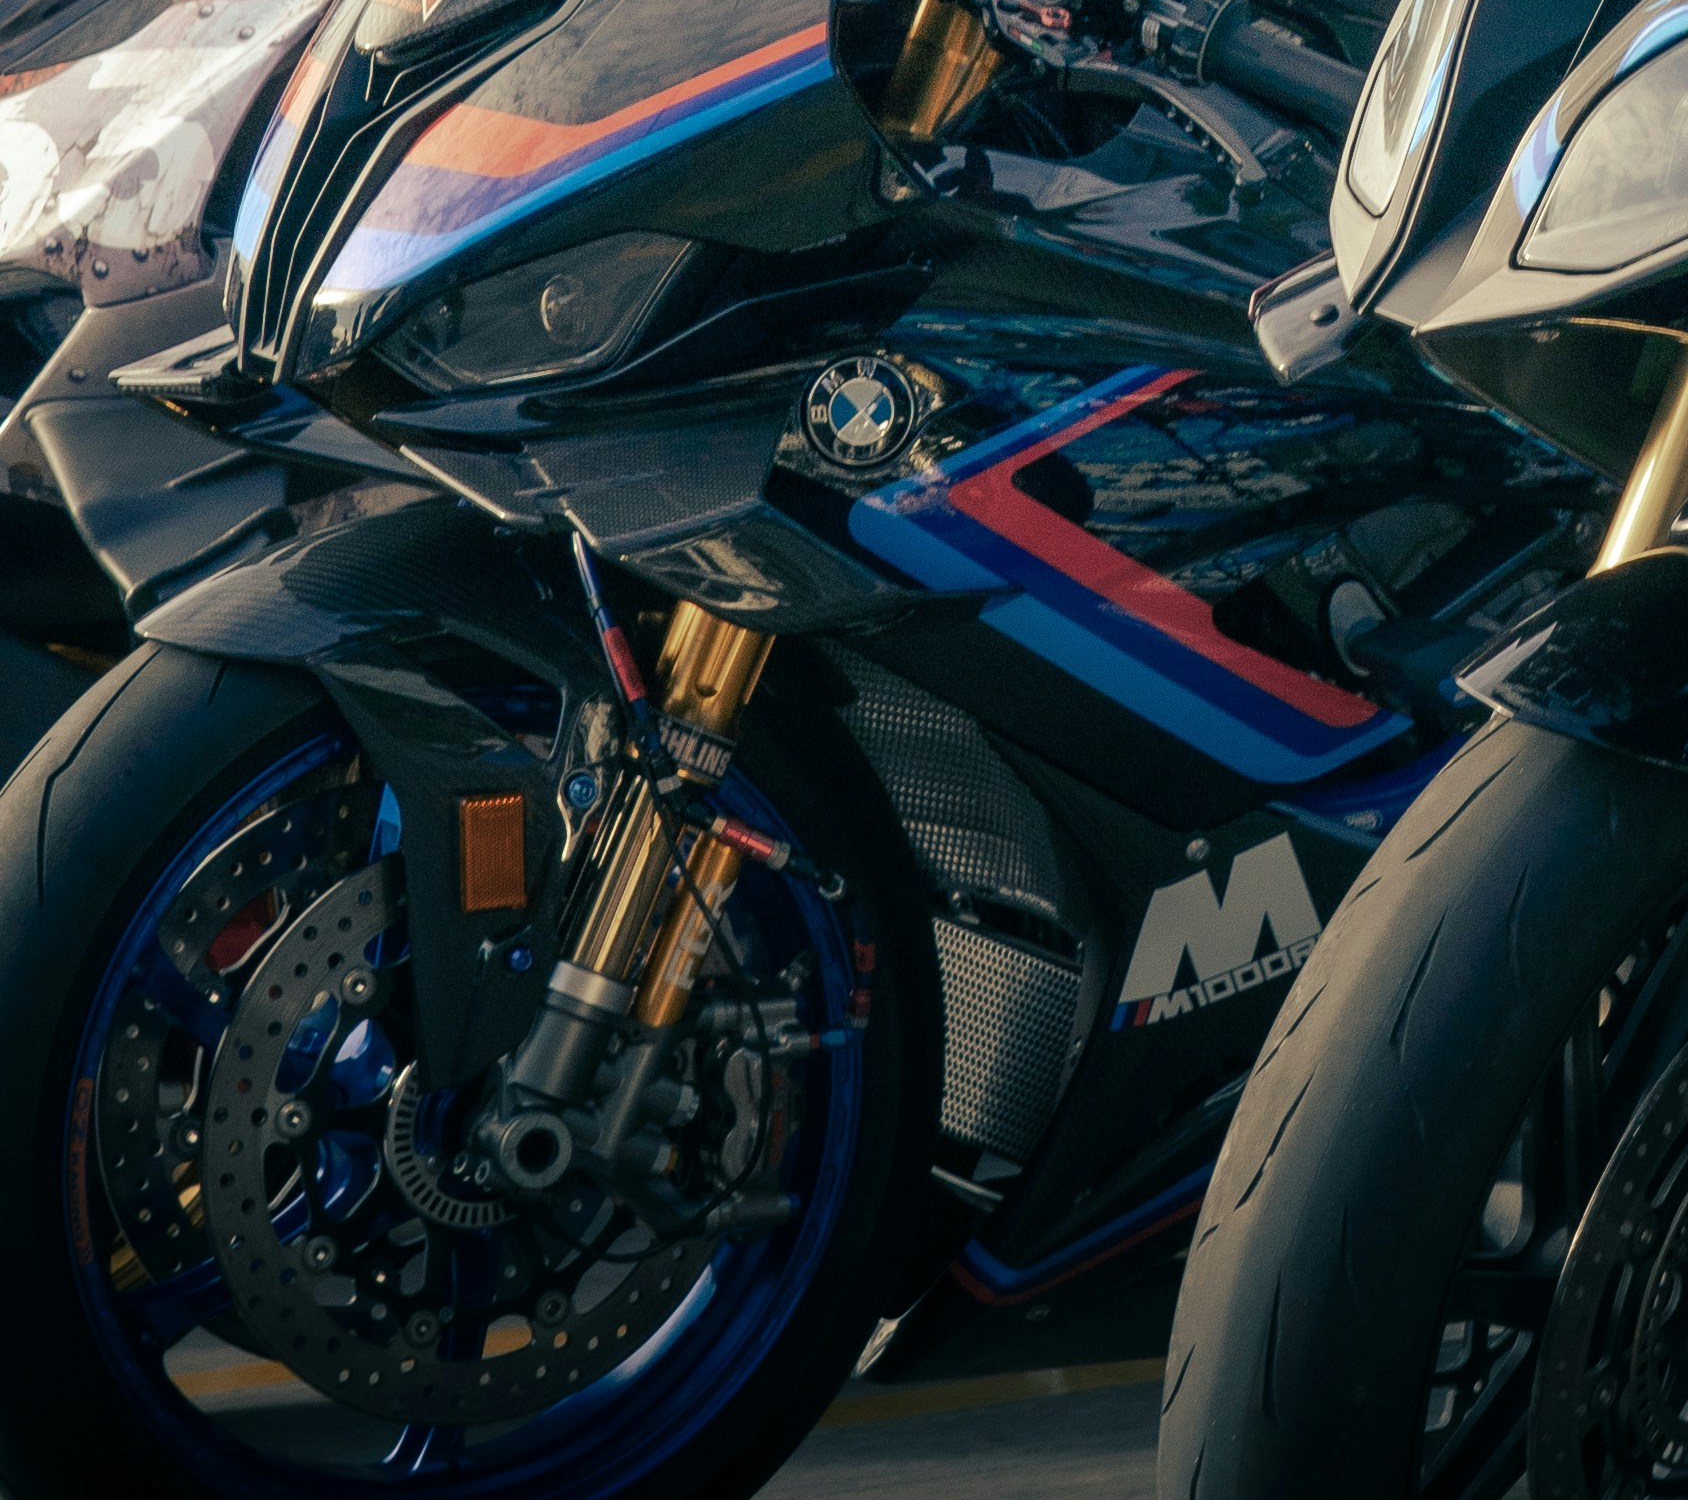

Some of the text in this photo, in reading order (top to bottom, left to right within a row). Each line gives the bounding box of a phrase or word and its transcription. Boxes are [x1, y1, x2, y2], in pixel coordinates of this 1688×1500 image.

[811, 358, 878, 424] BMW
[1119, 833, 1322, 1005] M
[1146, 933, 1321, 1026] M1000R
